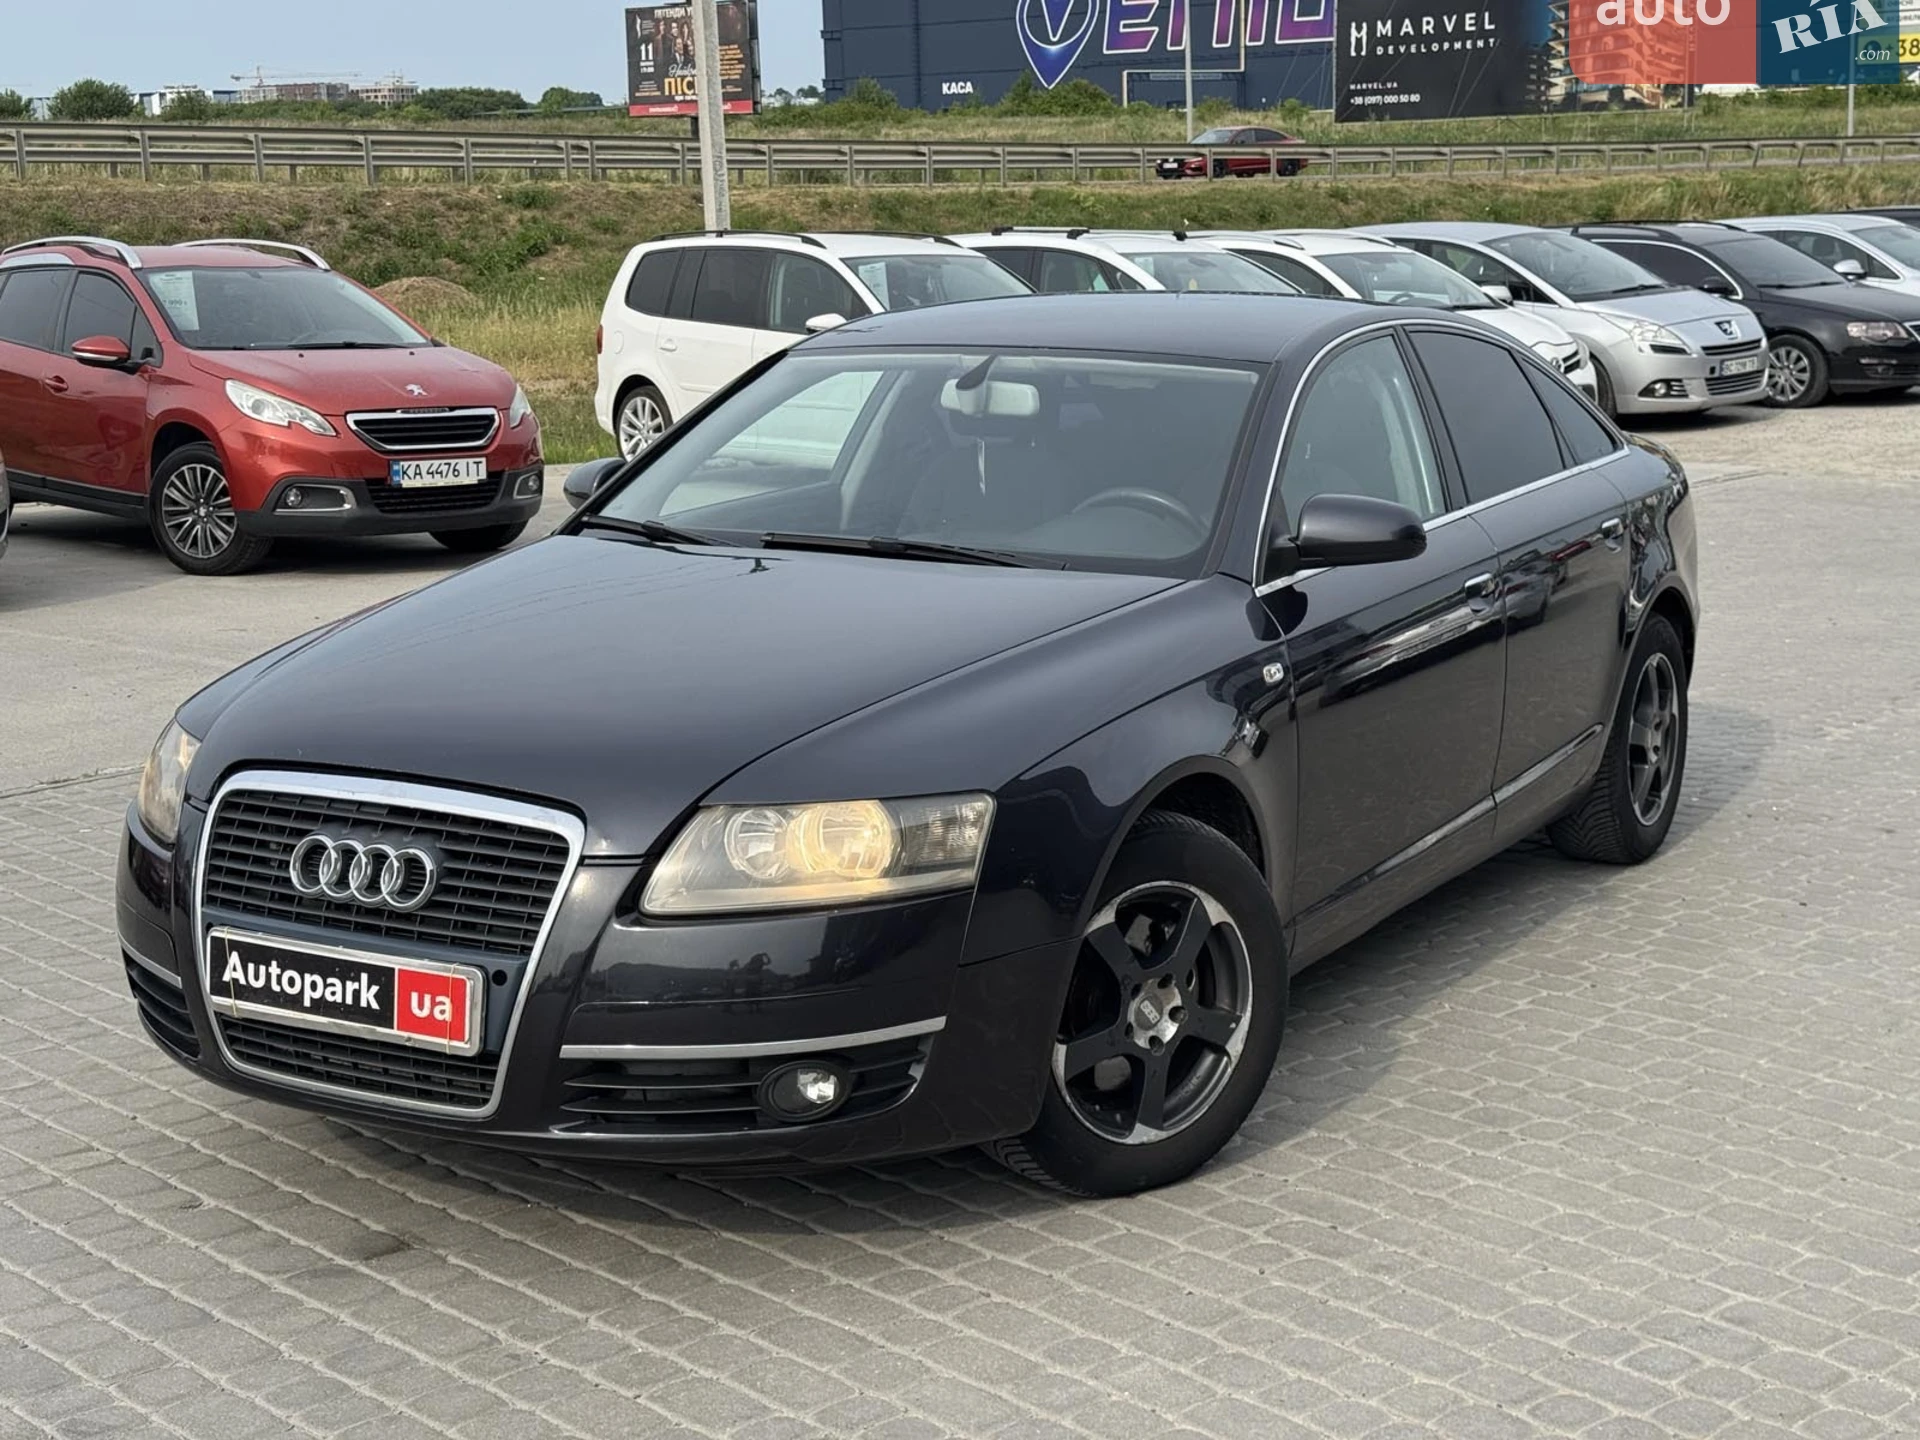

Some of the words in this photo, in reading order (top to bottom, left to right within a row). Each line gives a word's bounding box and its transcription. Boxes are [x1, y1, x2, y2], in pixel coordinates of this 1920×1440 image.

[1376, 11, 1496, 38] MARVEL
[639, 42, 654, 61] 11
[1376, 38, 1497, 56] DEVELOPMENT
[1349, 82, 1398, 91] MARVEL.UA
[401, 463, 424, 480] KA
[426, 462, 461, 479] 4476
[466, 461, 483, 477] IT
[222, 950, 381, 1010] Autopark
[409, 990, 453, 1022] ua
